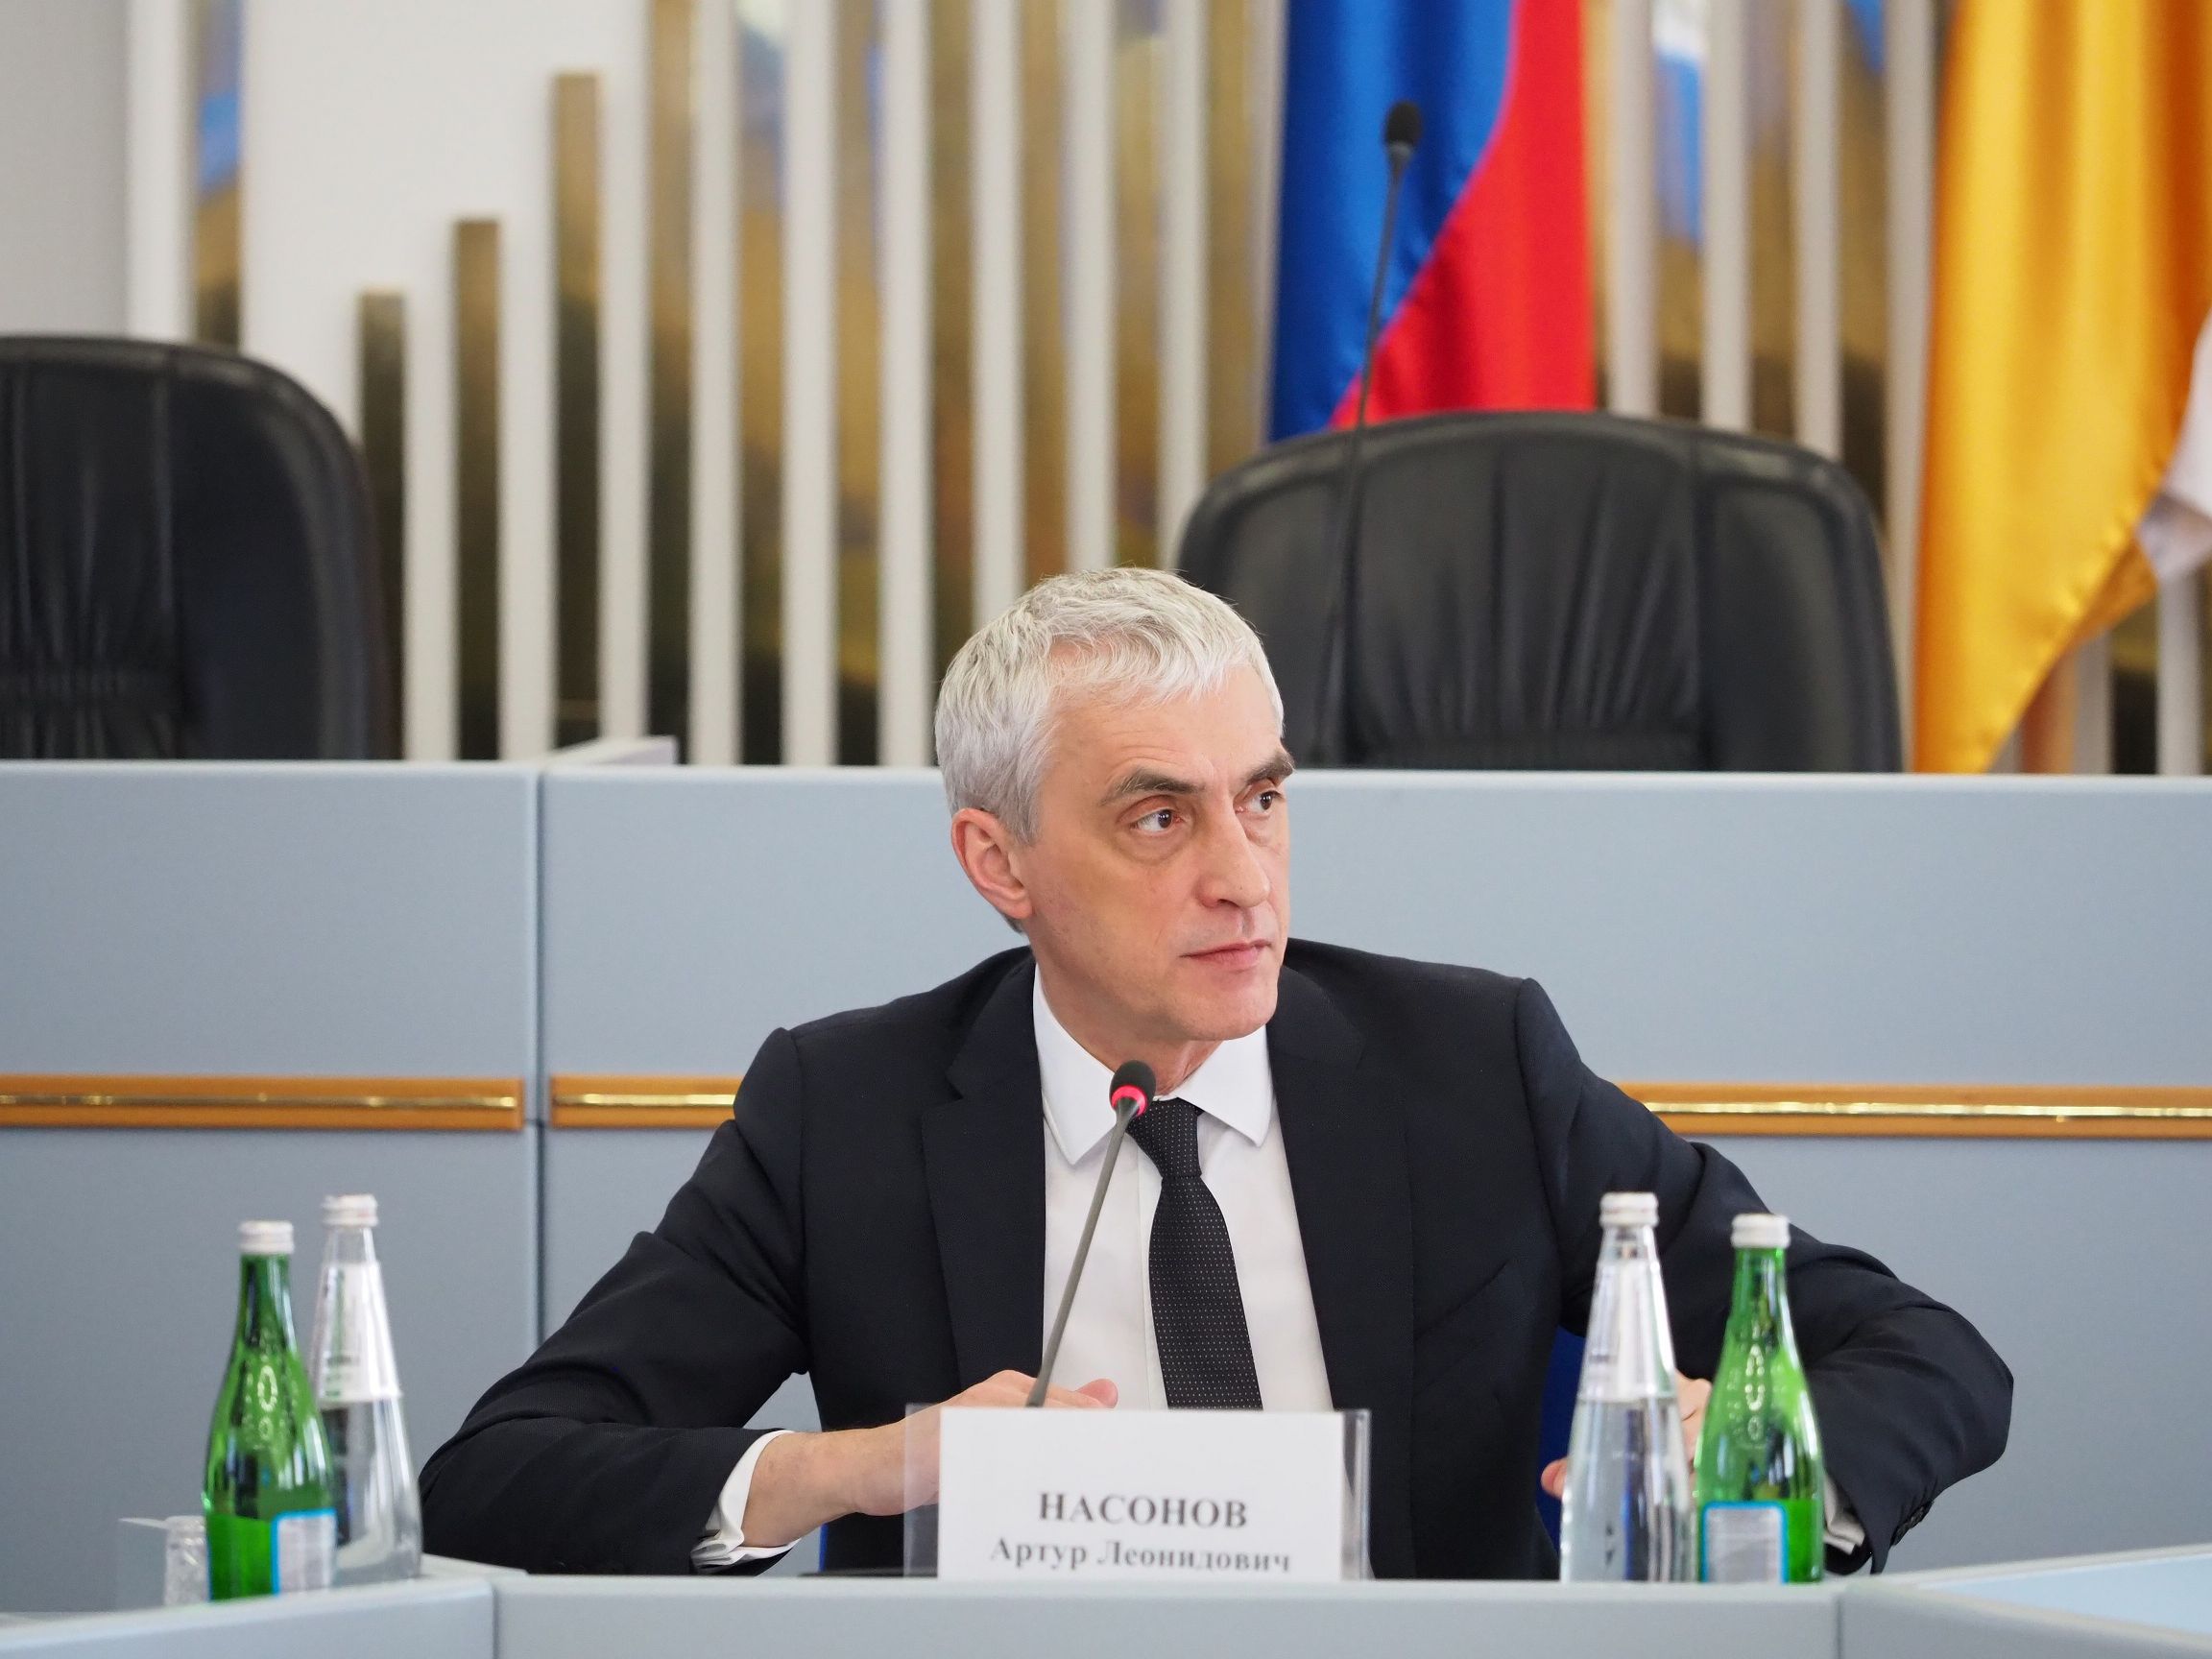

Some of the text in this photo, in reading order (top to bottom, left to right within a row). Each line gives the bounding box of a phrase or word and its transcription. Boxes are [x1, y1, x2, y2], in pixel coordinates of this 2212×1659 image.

[1039, 1492, 1248, 1529] НАСОНОВ
[991, 1537, 1290, 1573] Артур Леонидович
